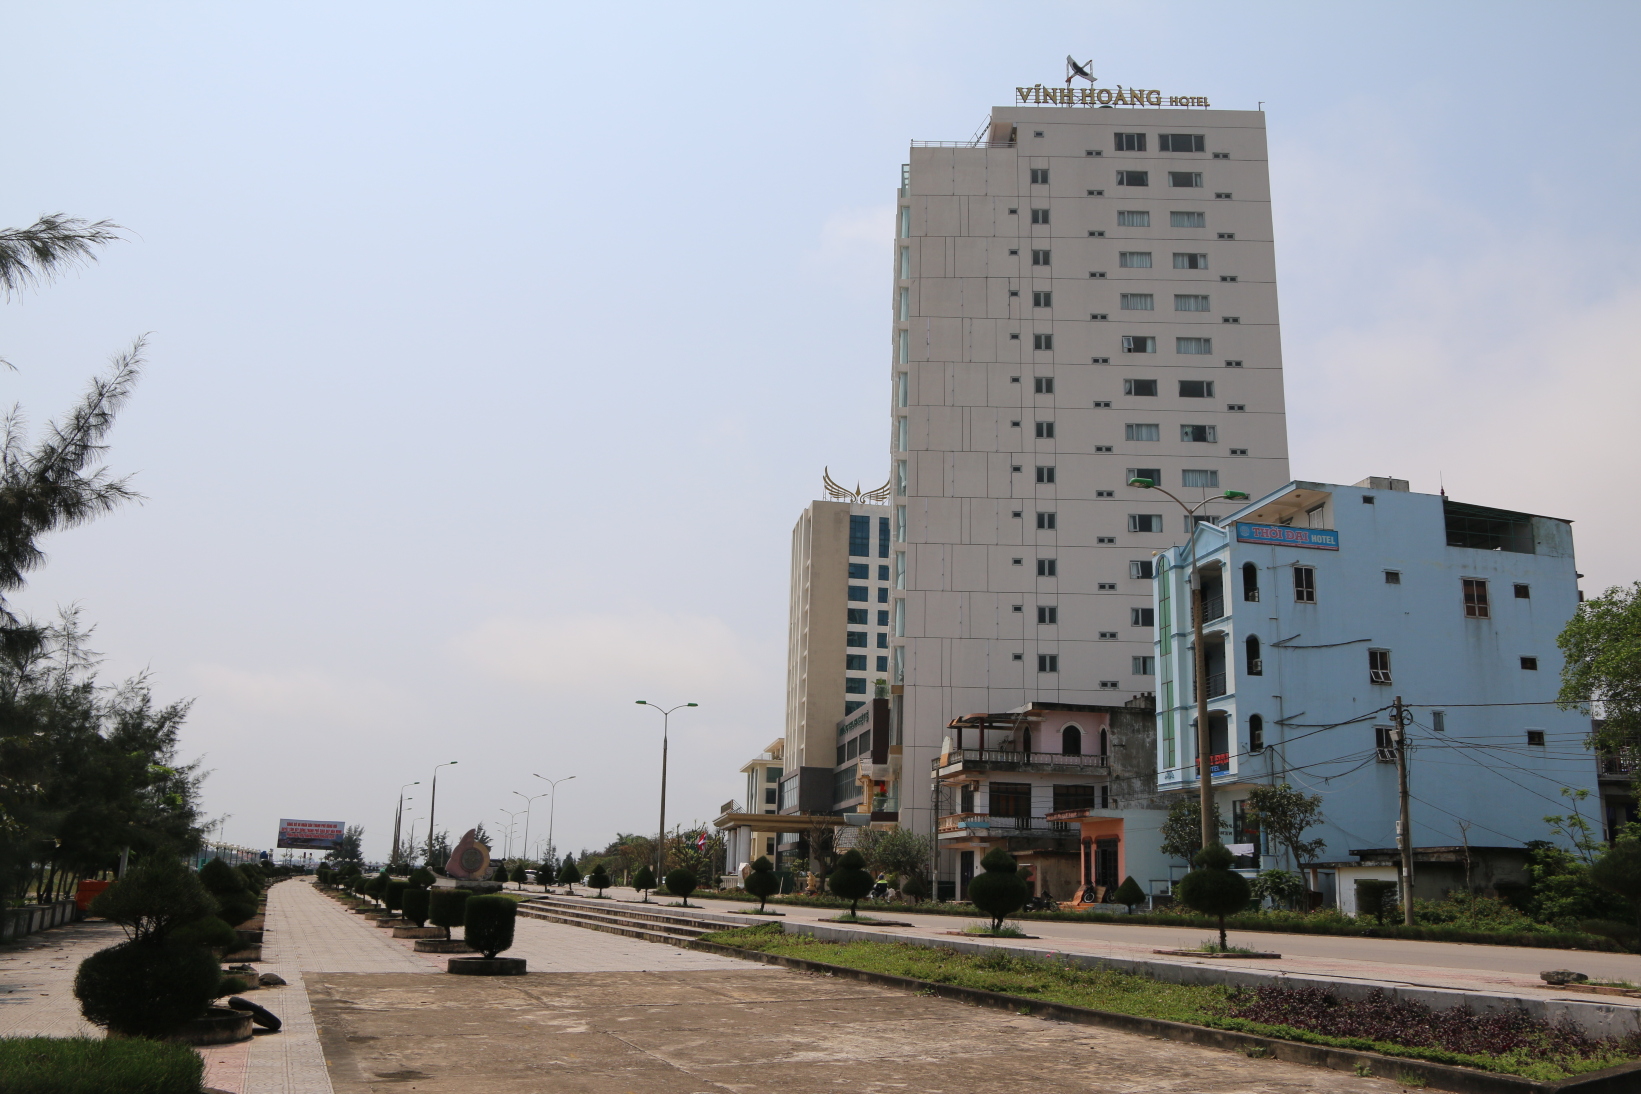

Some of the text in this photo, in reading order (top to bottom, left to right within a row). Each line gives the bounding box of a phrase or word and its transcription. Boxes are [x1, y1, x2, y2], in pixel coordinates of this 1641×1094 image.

[1081, 85, 1161, 107] HOÀNG
[1170, 96, 1210, 107] HOTEL
[1311, 534, 1336, 545] HOTEL
